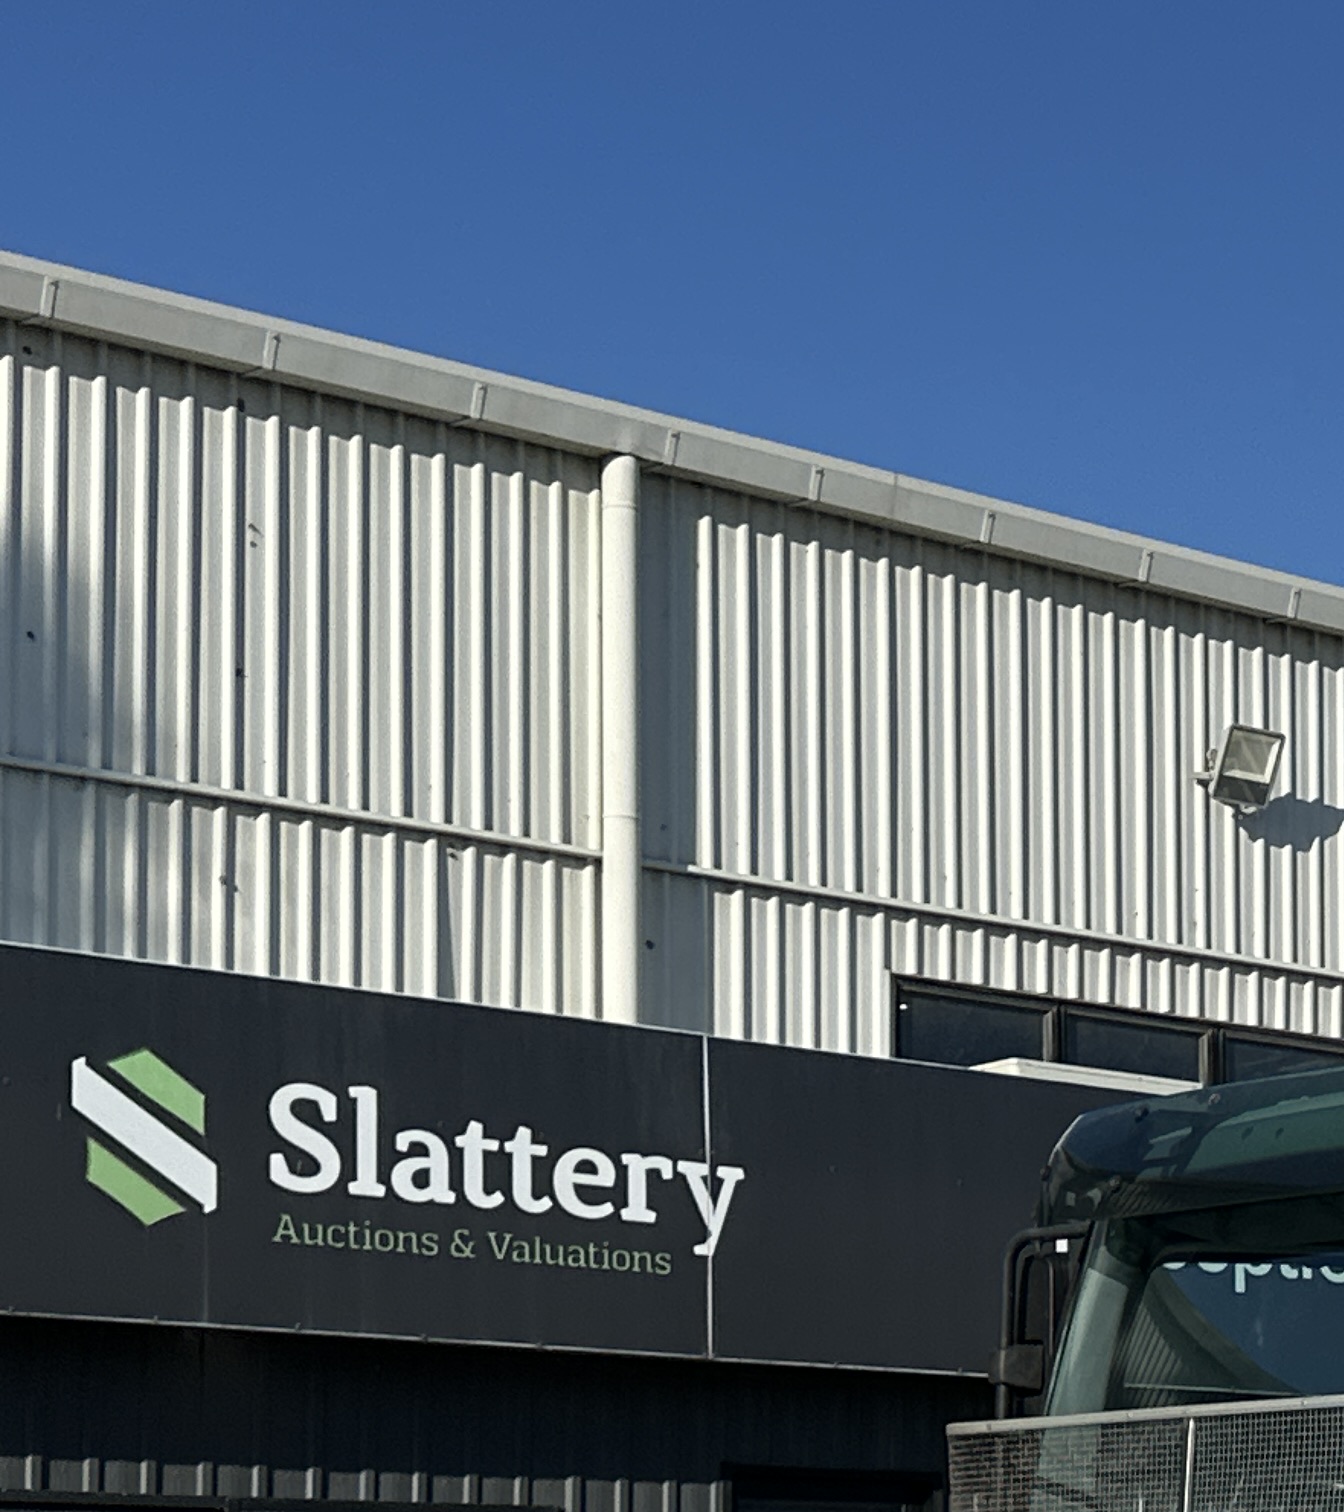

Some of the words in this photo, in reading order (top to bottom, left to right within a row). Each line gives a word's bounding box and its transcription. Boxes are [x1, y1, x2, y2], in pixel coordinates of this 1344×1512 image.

[268, 1082, 745, 1256] Slattery
[272, 1213, 439, 1257] Auctions
[450, 1229, 476, 1259] &
[487, 1231, 672, 1276] Valuations
